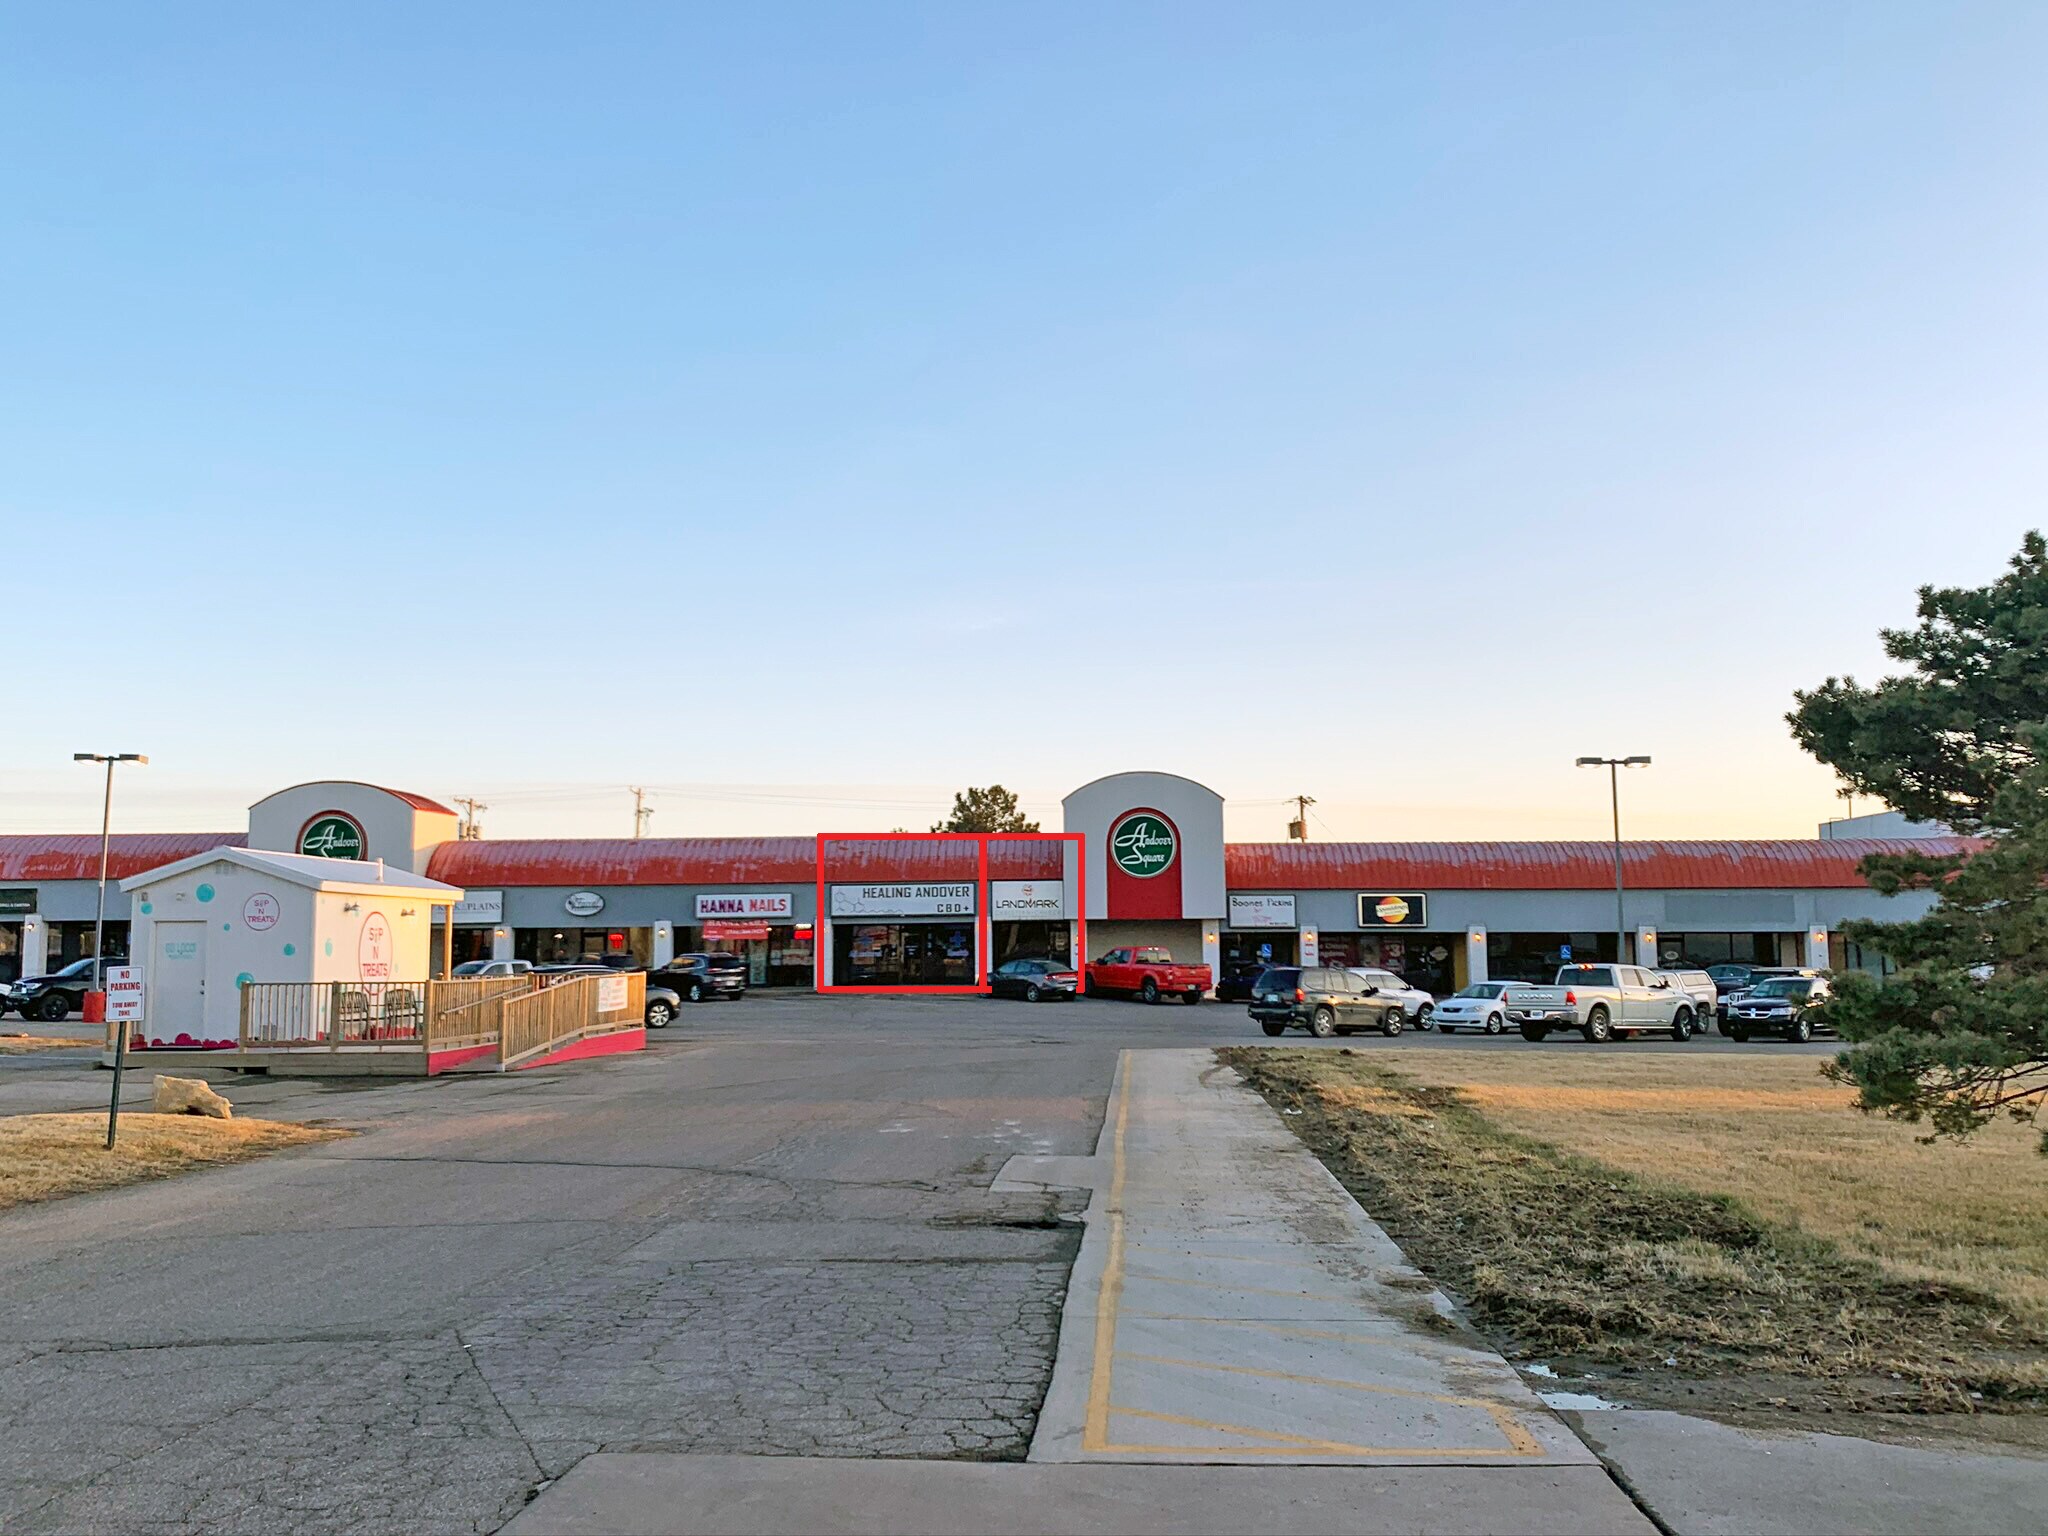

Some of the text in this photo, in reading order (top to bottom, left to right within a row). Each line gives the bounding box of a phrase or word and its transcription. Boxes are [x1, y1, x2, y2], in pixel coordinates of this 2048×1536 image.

[303, 824, 359, 850] Andover
[1115, 822, 1172, 848] Andover
[1120, 842, 1165, 868] Square
[863, 886, 969, 898] HEALING ANDOVER
[466, 902, 501, 911] PLAINS
[700, 898, 786, 913] HANNA NAILS
[996, 899, 1059, 909] LANDMARK
[247, 915, 275, 923] TREATS
[120, 971, 130, 979] NO
[362, 963, 388, 977] TREATS
[110, 981, 141, 991] PARKING
